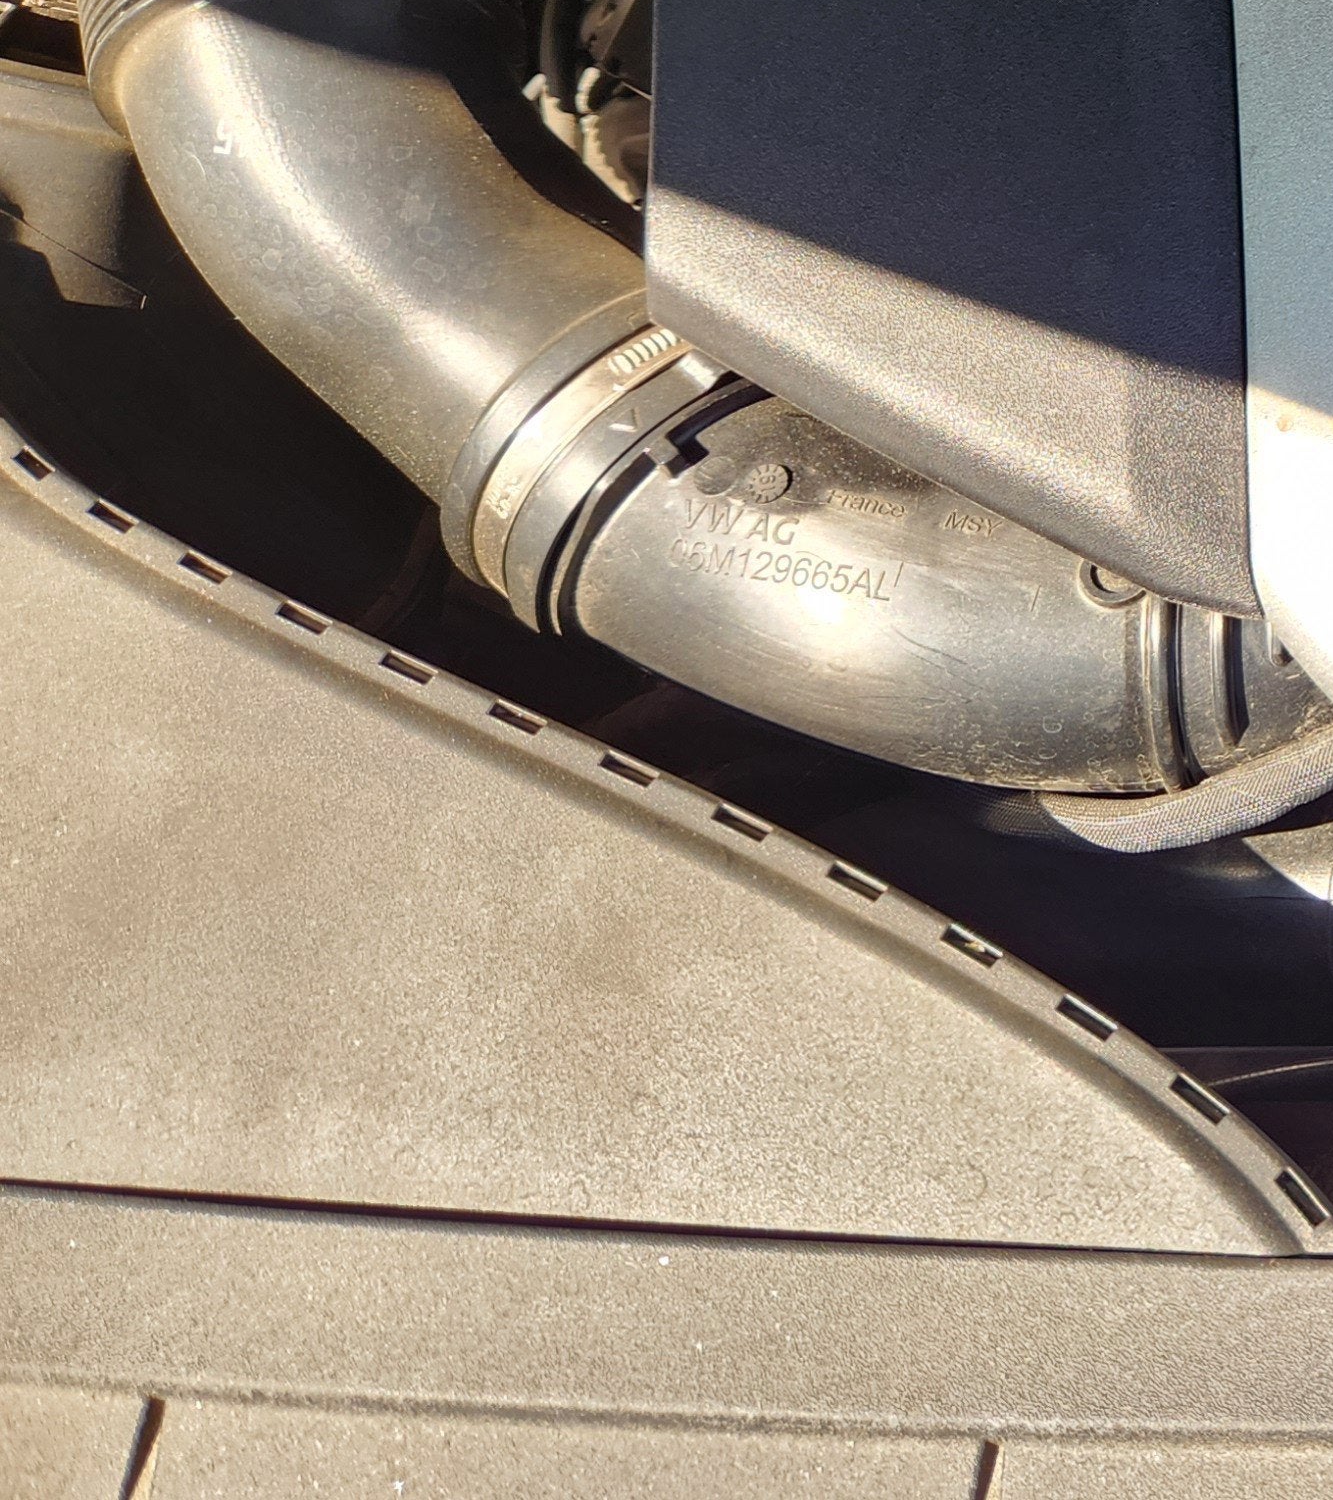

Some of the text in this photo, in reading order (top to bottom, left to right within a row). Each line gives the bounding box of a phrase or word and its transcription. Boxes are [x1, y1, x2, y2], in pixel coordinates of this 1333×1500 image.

[683, 497, 801, 545] VW AG
[826, 488, 907, 519] France
